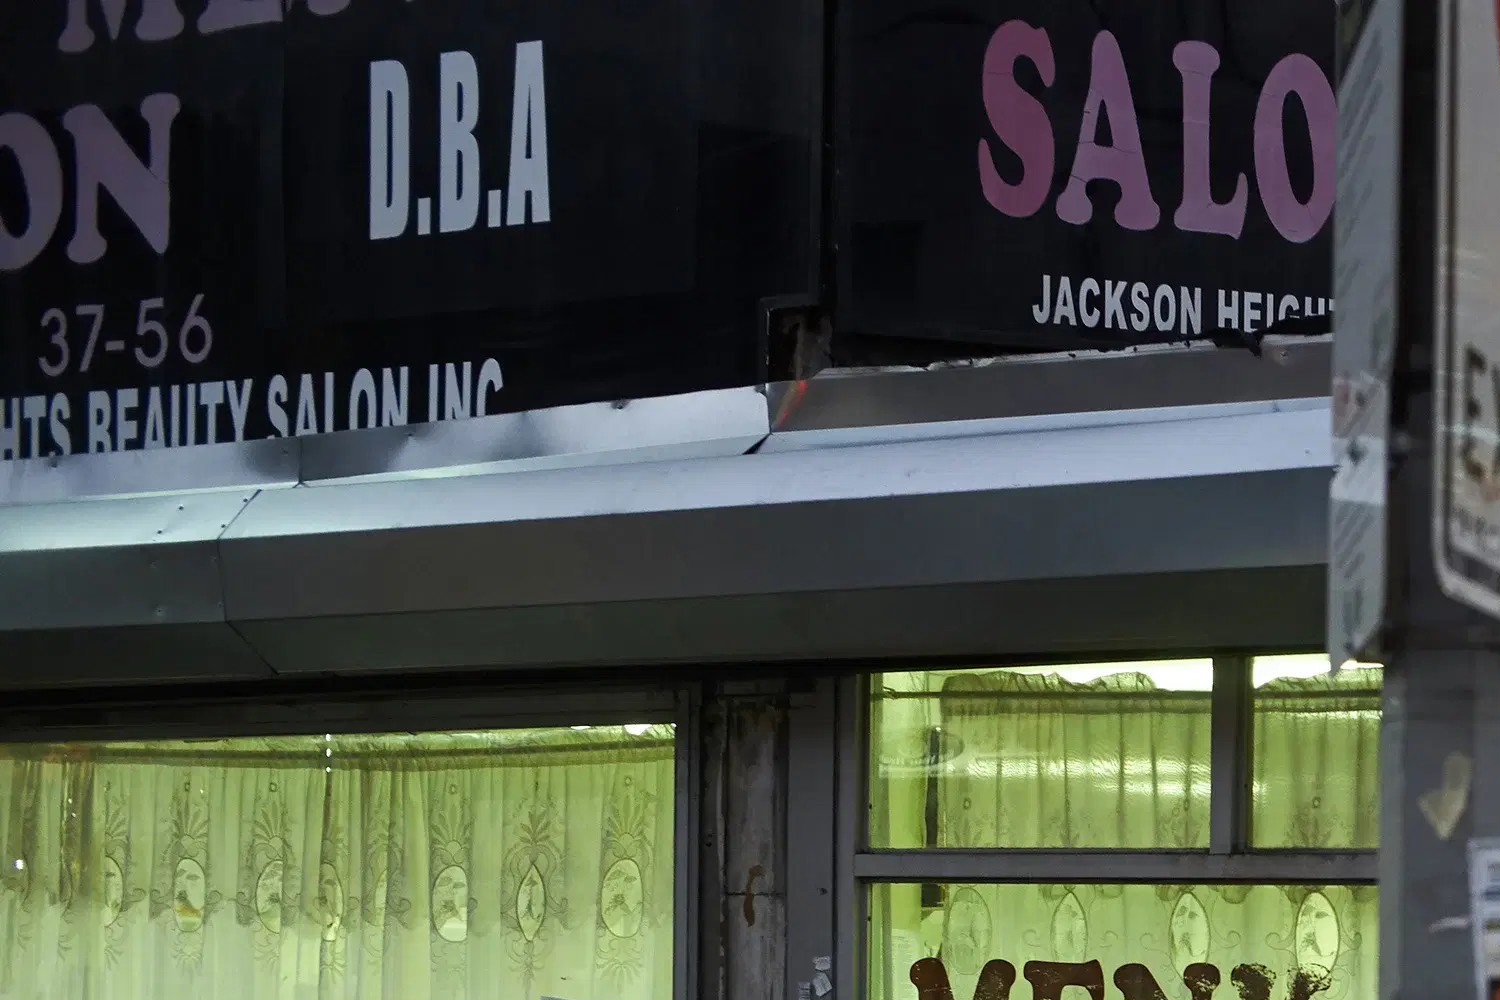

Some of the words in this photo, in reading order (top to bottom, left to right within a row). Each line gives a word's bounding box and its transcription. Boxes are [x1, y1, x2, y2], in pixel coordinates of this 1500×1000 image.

[369, 40, 550, 240] D.B.A
[38, 293, 213, 378] 37-56
[1032, 274, 1202, 336] JACKSON
[88, 377, 253, 454] BEAUTY
[267, 366, 409, 440] SALON
